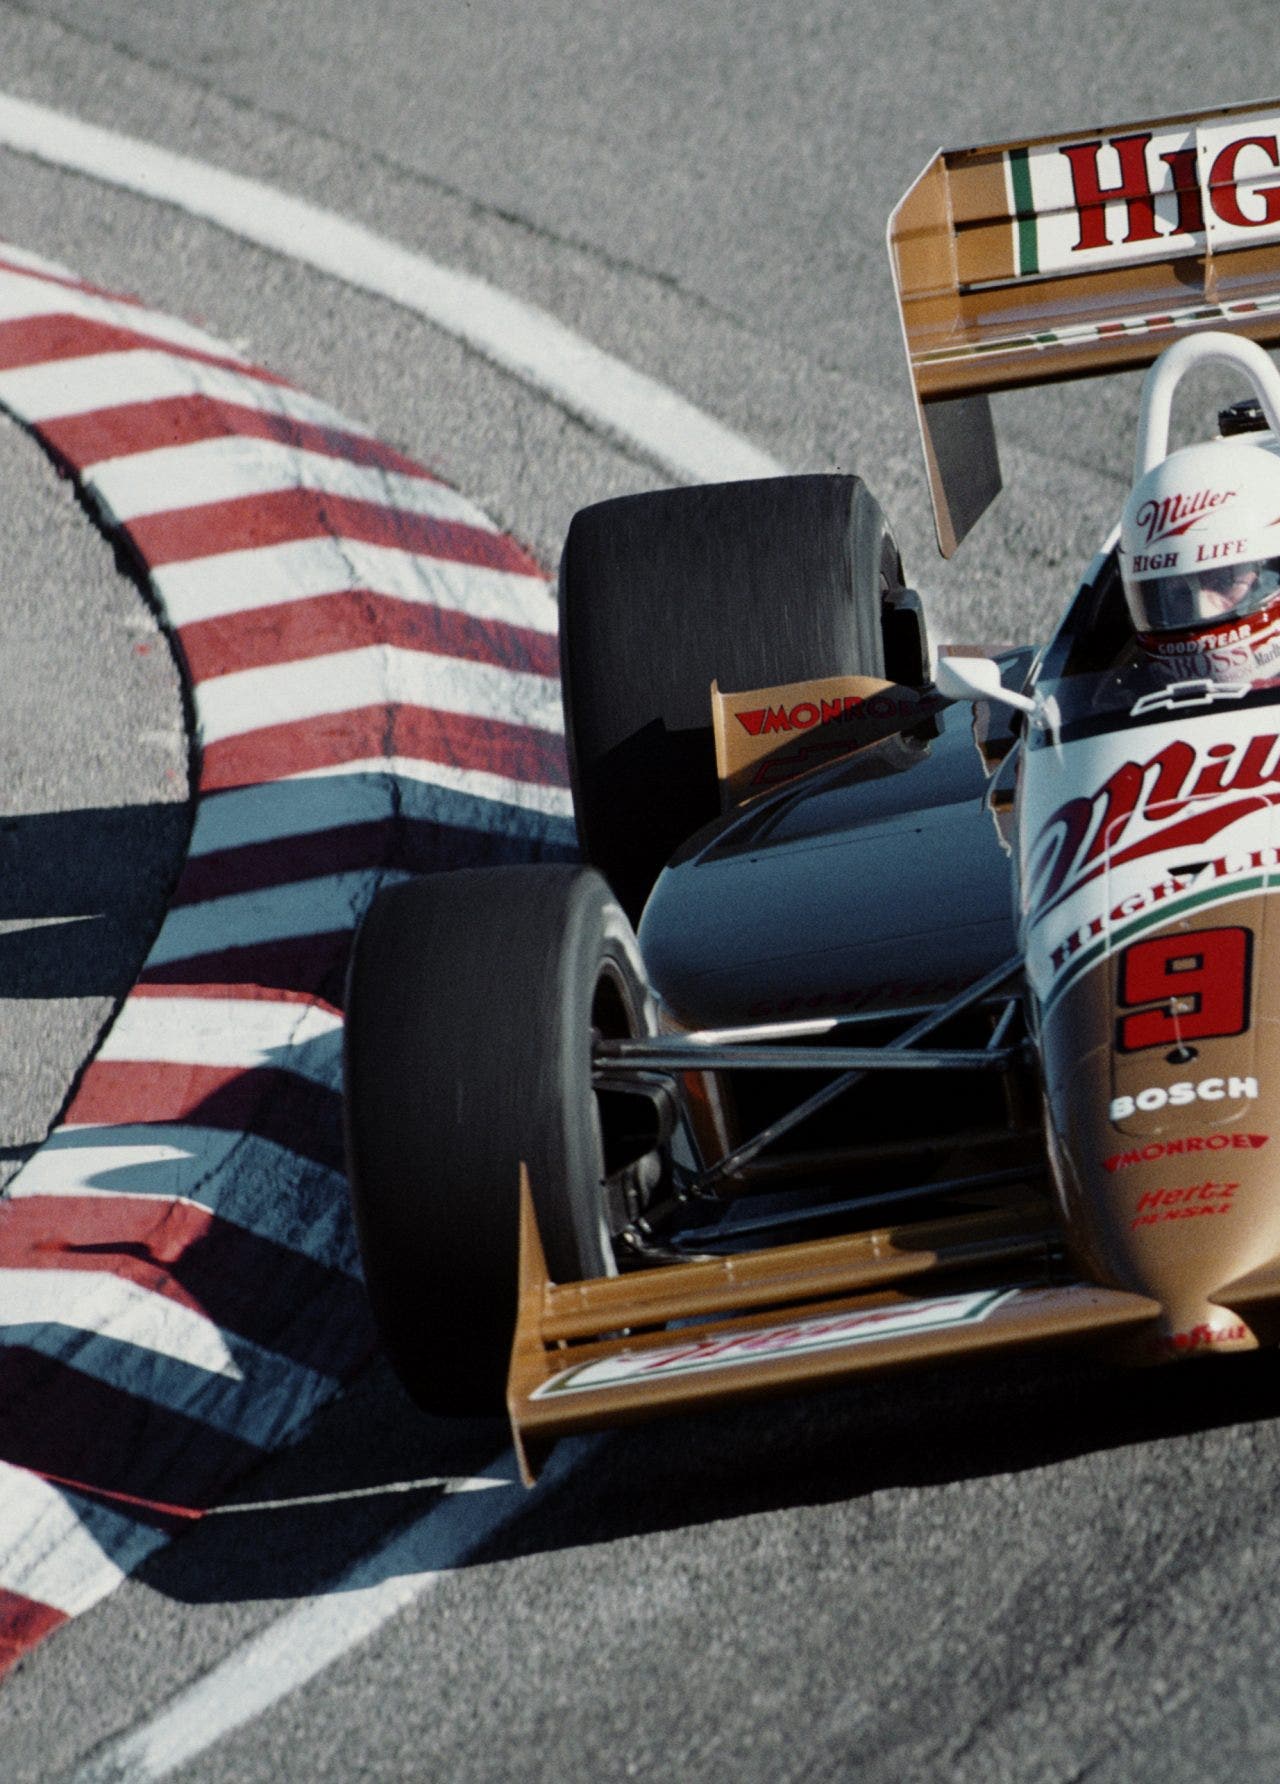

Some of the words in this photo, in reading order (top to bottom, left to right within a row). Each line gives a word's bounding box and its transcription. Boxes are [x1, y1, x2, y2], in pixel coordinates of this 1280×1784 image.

[1136, 489, 1236, 545] Miller
[1133, 552, 1179, 574] HIGH
[1195, 539, 1247, 564] LIFE
[1158, 624, 1251, 654] GOODYEAR
[1049, 874, 1190, 970] HIGH
[1117, 926, 1254, 1055] 9
[1109, 1076, 1259, 1121] BOSCH
[1118, 1134, 1251, 1169] MONROE
[1138, 1180, 1240, 1213] Hertz
